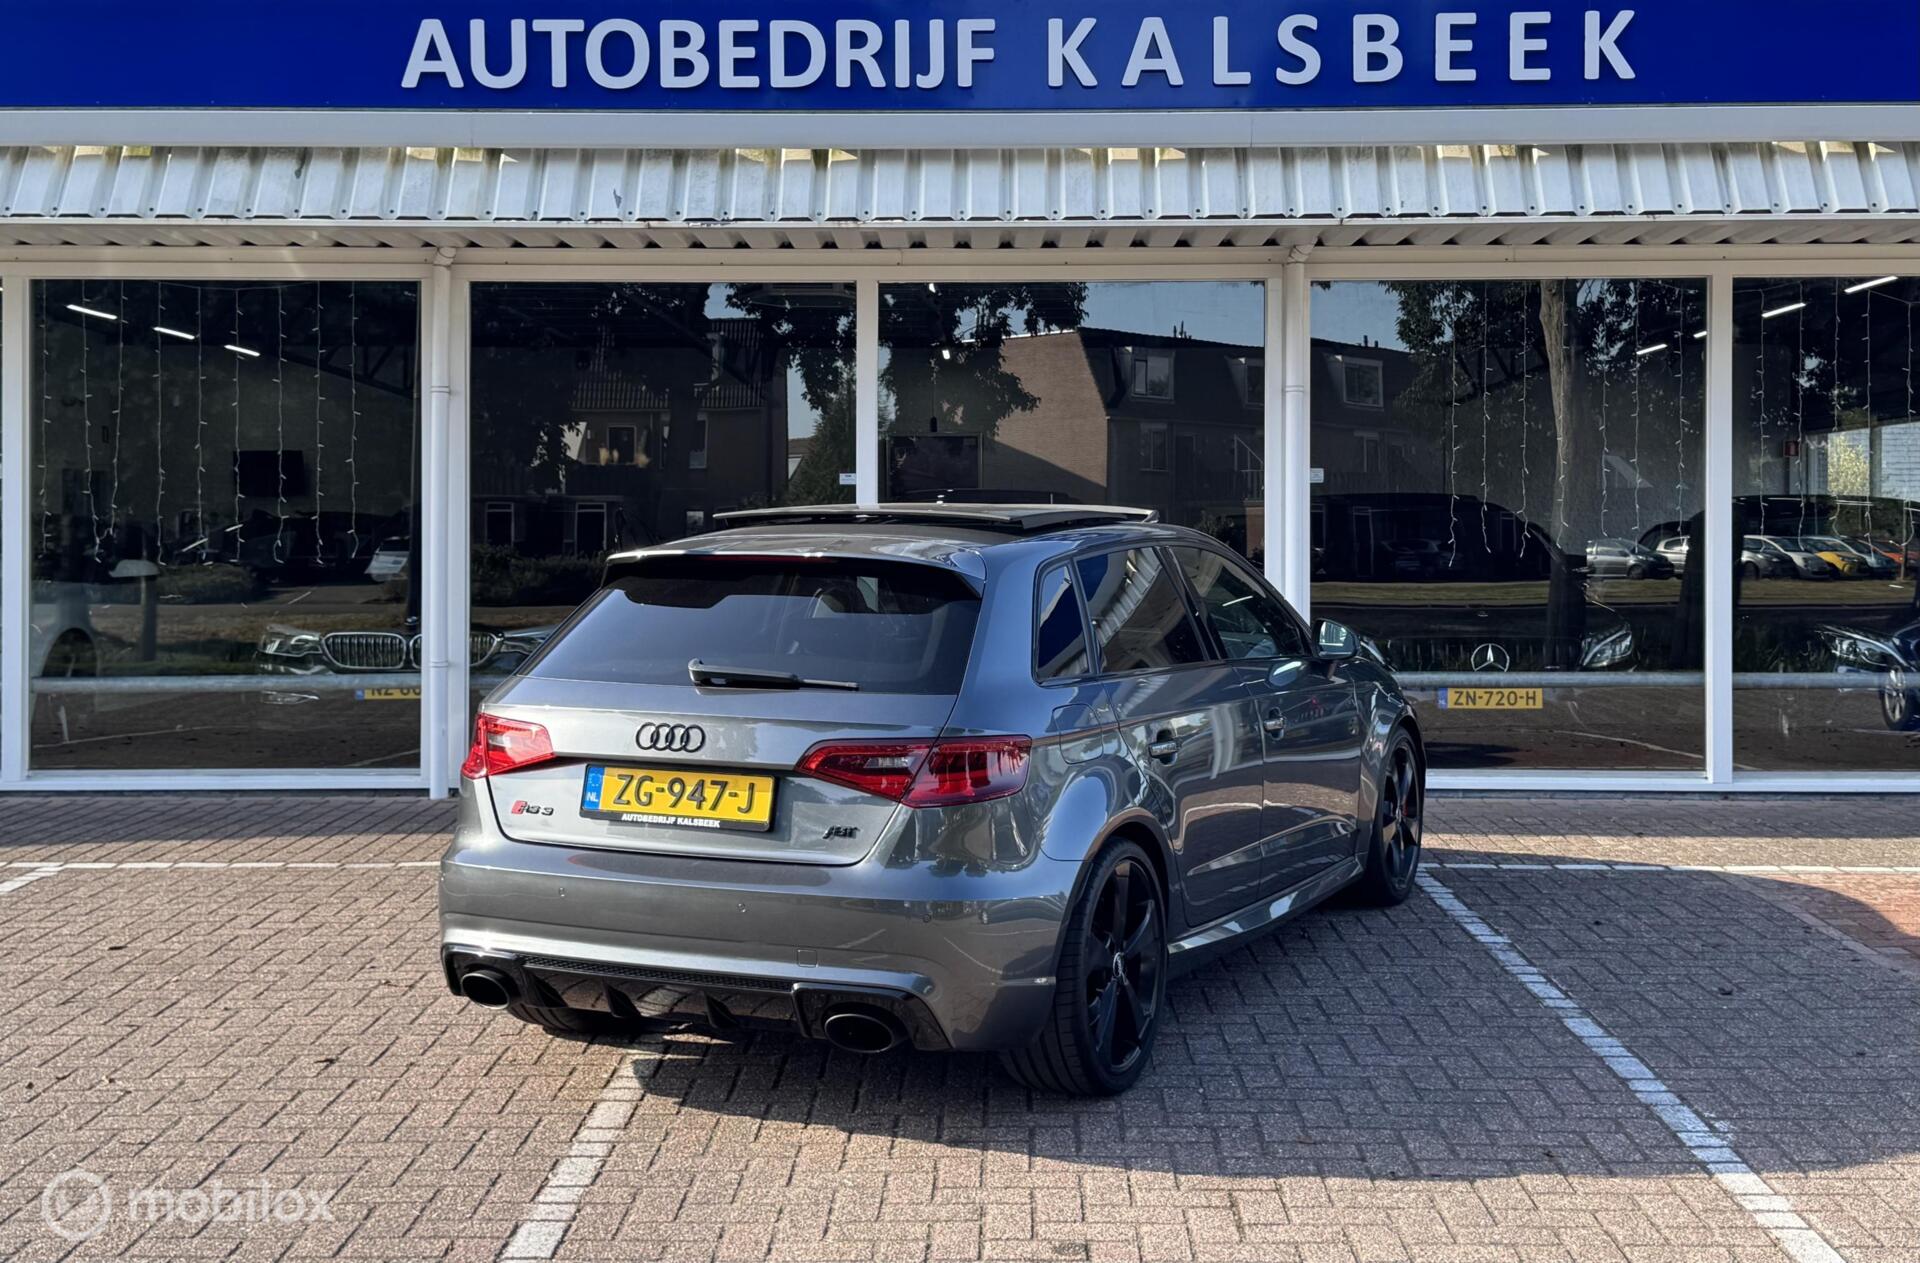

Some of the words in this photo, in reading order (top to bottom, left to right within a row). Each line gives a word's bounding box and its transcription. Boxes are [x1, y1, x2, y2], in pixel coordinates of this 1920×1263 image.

[401, 18, 996, 89] AUTOBEDRIJF
[1047, 10, 1636, 87] KALSBEEK
[1453, 690, 1536, 706] ZN-720-H
[586, 792, 598, 802] NL
[613, 774, 755, 814] ZG-947-J
[621, 813, 676, 824] AUTOBEDRIJF
[677, 817, 721, 828] KALSBEEK
